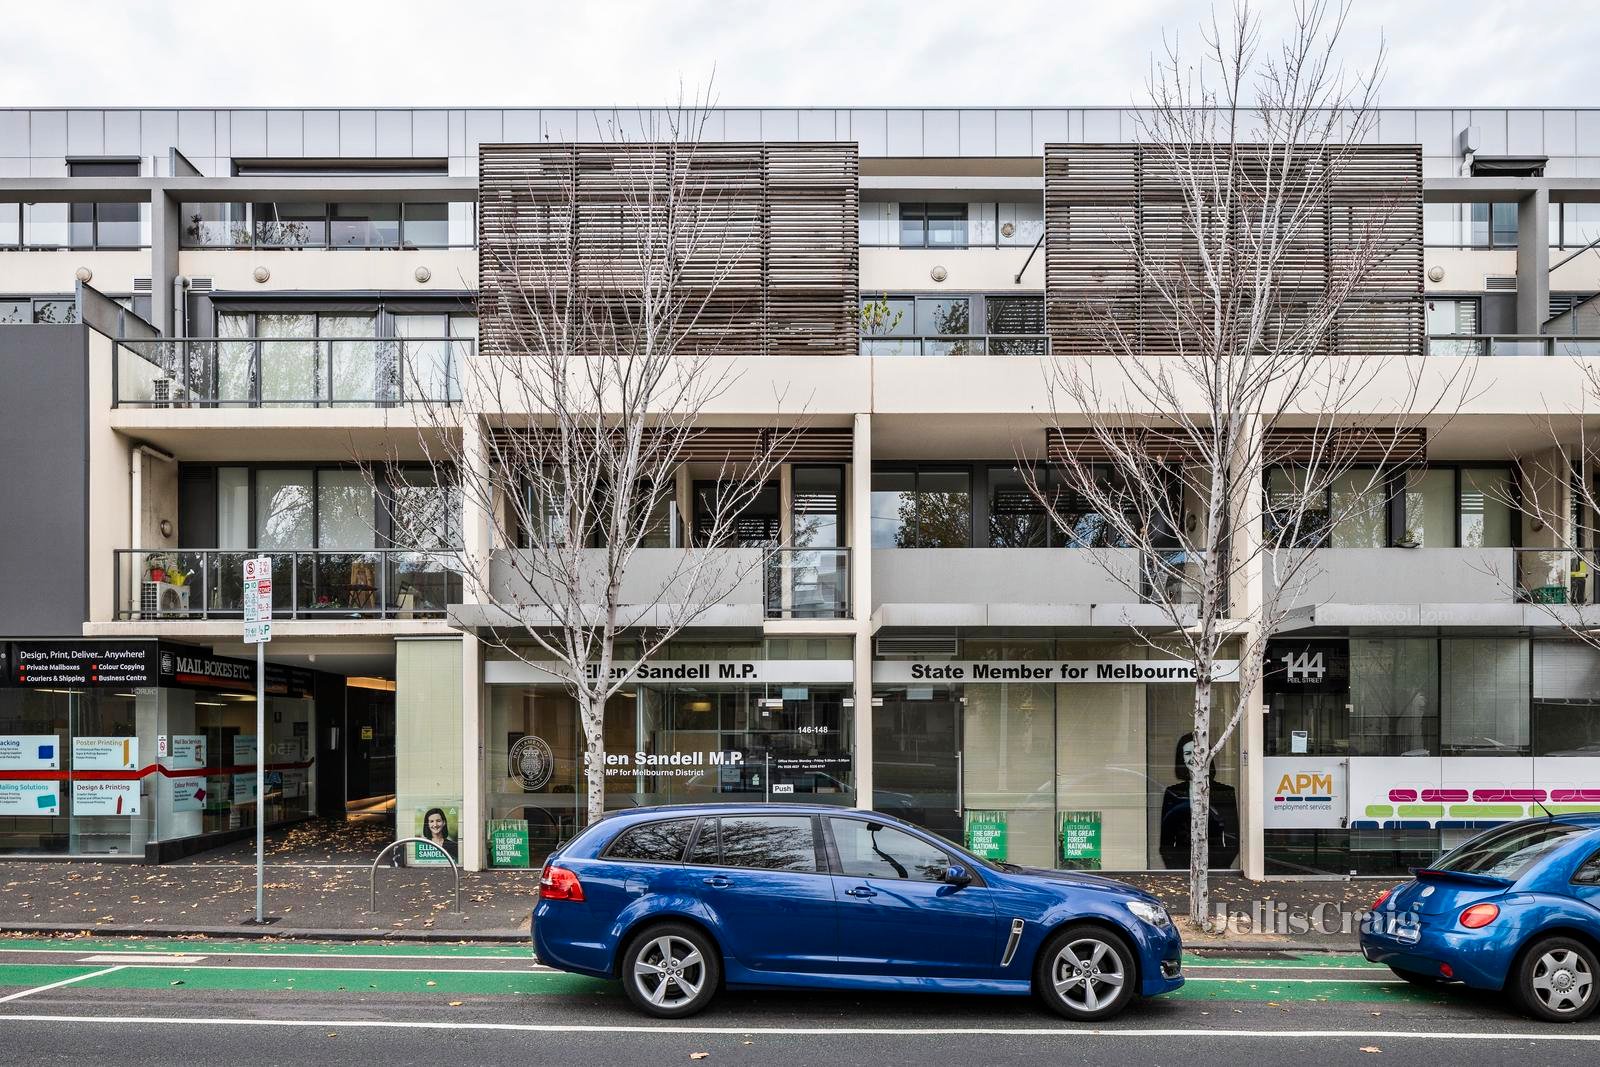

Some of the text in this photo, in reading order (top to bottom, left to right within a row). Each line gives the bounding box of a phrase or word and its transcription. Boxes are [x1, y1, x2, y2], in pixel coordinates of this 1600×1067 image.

[20, 651, 48, 660] Design,
[50, 651, 70, 659] Print,
[104, 650, 145, 660] Anywhere!
[176, 656, 204, 674] MAIL
[204, 660, 232, 679] BOXES
[637, 664, 709, 679] Sandell
[719, 664, 757, 678] M.P.
[911, 664, 1198, 679] State Member for Melbourne
[1282, 652, 1326, 677] 144
[584, 752, 744, 765] len Sandell M.P.
[1277, 774, 1332, 794] APM
